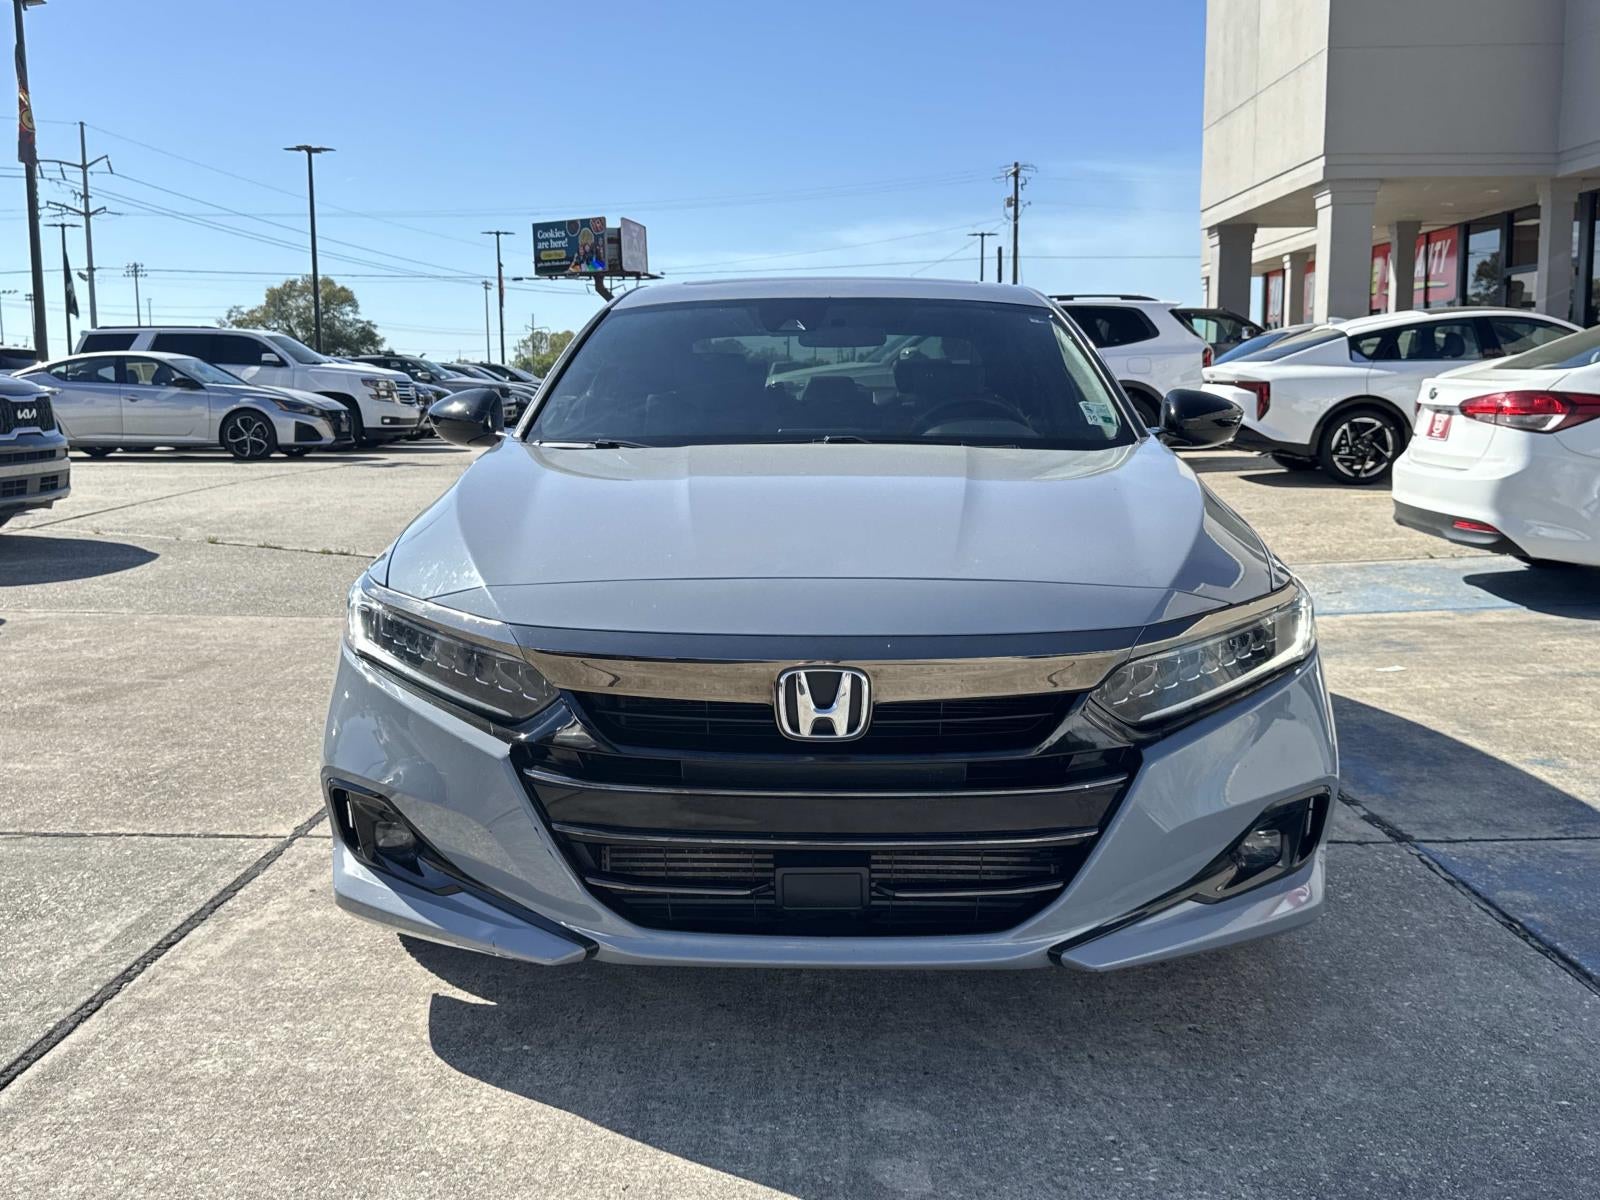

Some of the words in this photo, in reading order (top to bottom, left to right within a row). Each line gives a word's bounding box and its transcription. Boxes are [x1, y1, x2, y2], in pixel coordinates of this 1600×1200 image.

[537, 228, 566, 240] Cookies
[537, 241, 549, 249] are
[550, 238, 568, 248] here!
[17, 408, 37, 419] KIA
